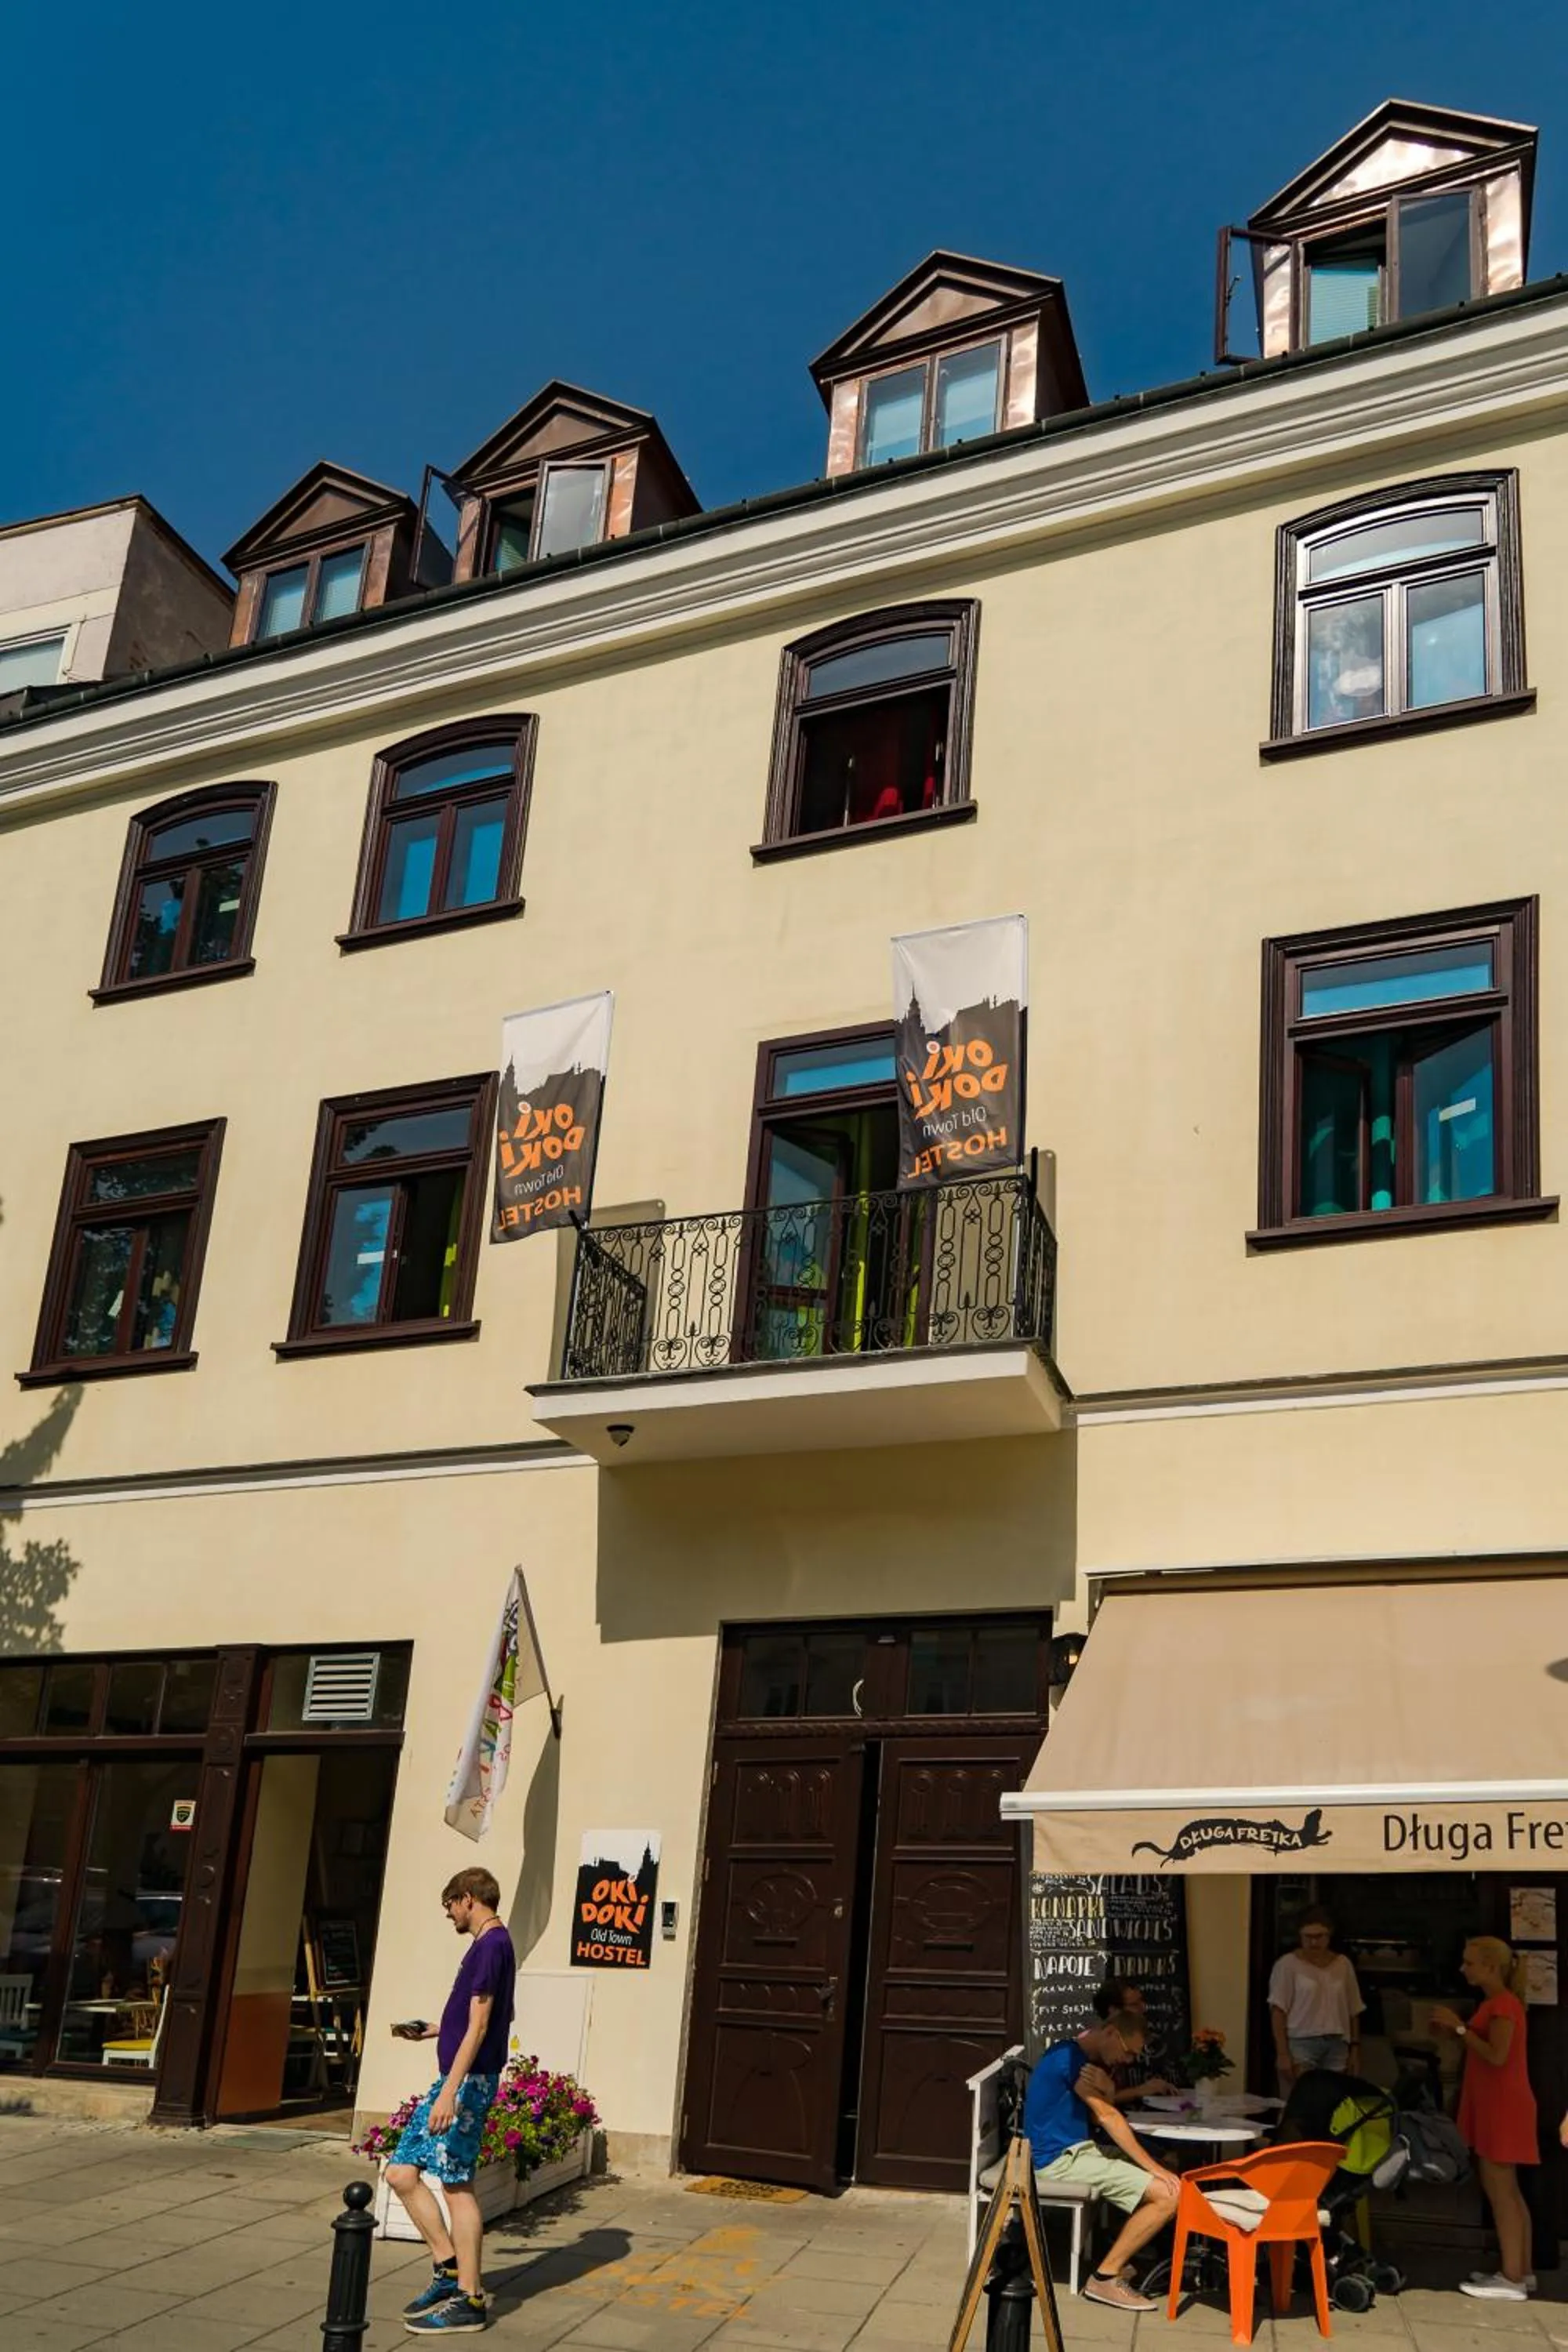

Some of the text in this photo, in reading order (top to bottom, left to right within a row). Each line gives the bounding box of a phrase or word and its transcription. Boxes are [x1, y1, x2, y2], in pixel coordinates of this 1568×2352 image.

[1180, 1826, 1234, 1849] DŁUGA
[1384, 1812, 1568, 1860] Długa Fre
[590, 1928, 633, 1947] Old Town
[576, 1941, 646, 1966] HOSTEL
[1034, 1956, 1095, 1980] NAPOJE
